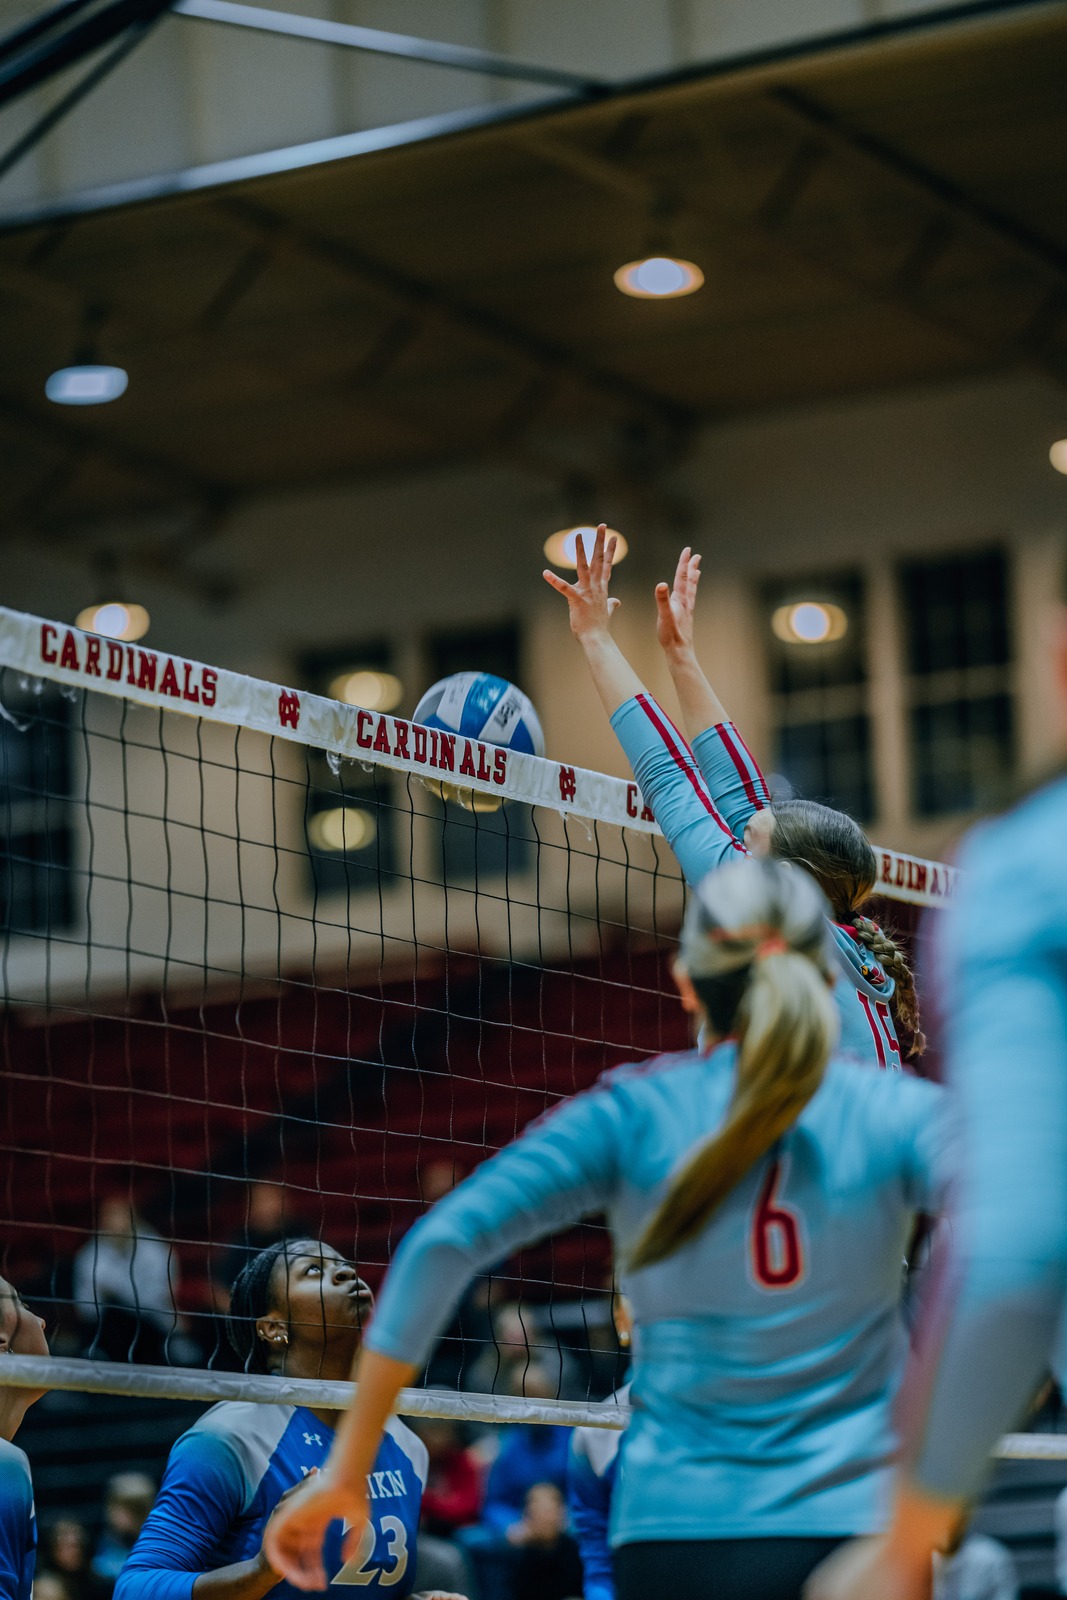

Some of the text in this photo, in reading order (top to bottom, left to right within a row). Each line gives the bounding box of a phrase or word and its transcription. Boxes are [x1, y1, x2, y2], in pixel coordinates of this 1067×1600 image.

[40, 623, 218, 707] CARDINALS
[356, 710, 508, 785] CARDINALS
[749, 1157, 806, 1291] 6
[330, 1515, 408, 1586] 23
